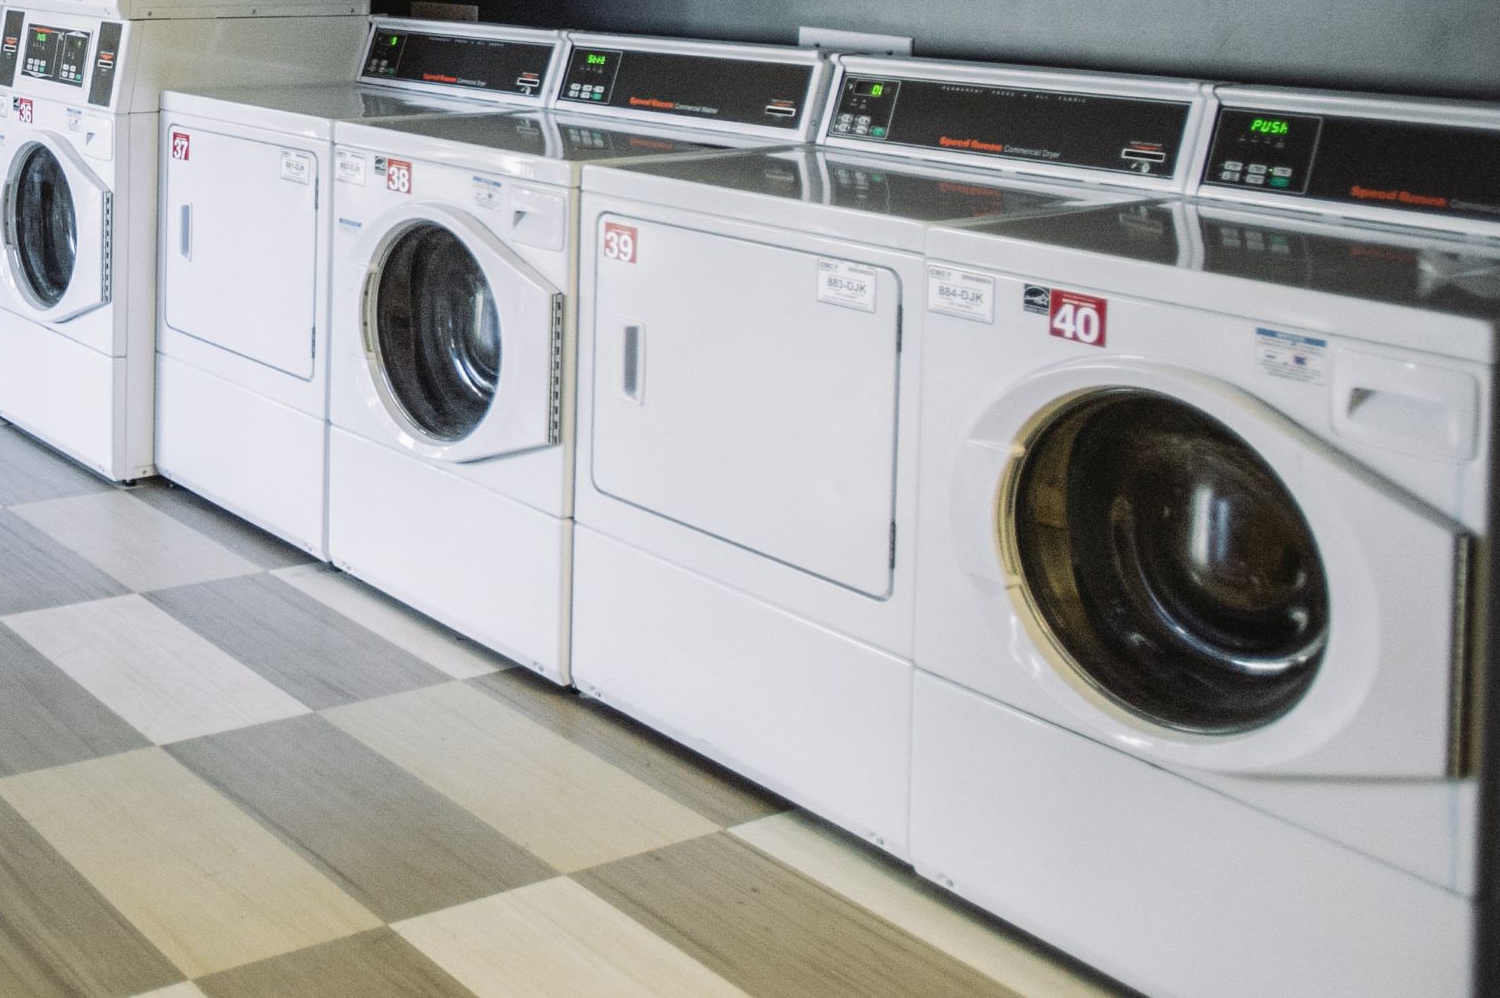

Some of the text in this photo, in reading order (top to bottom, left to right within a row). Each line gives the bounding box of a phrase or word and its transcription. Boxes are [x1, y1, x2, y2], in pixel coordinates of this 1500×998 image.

[20, 103, 32, 122] 36
[174, 138, 188, 160] 37
[939, 136, 1061, 159] Speed Queen Commercial Dryer
[389, 166, 409, 193] 38
[605, 231, 634, 262] 39
[828, 277, 867, 294] 883-DJK
[938, 285, 983, 304] 884-DJK
[1053, 303, 1100, 344] 40
